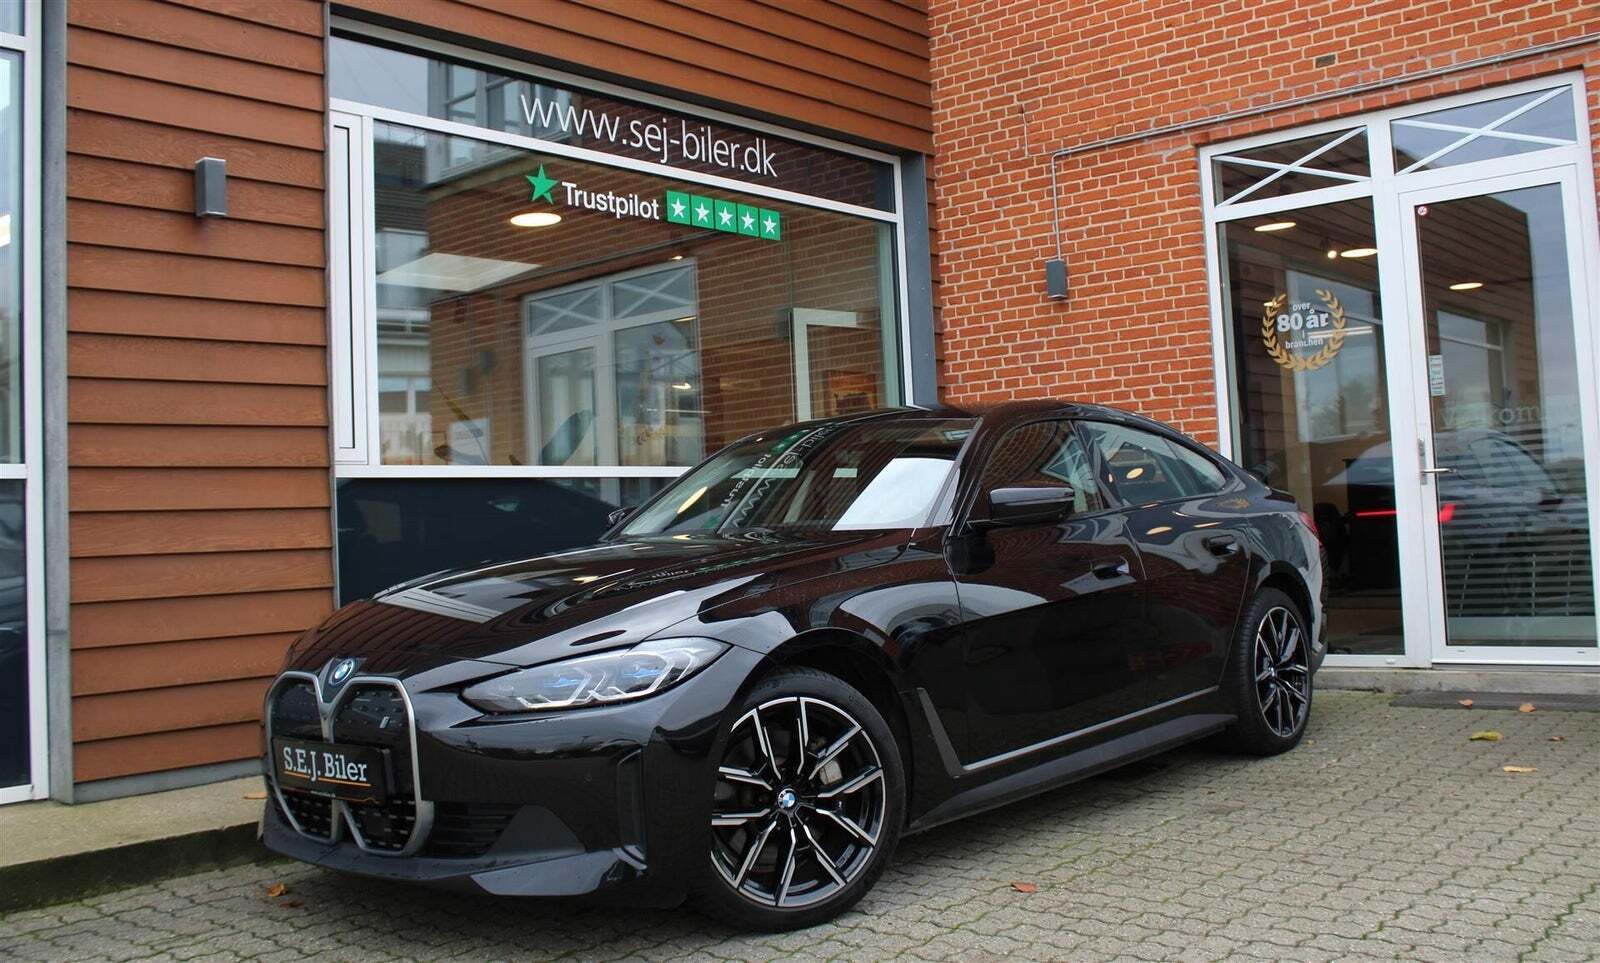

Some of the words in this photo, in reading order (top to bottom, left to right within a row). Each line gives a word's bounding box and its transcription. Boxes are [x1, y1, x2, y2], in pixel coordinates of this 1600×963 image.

[520, 94, 778, 177] www.sej-biler.dk
[561, 181, 660, 221] Trustpilot
[1276, 312, 1303, 332] 80
[1305, 308, 1329, 329] år
[1292, 302, 1311, 312] over
[283, 746, 321, 782] S.E.J.
[324, 753, 368, 782] Biler
